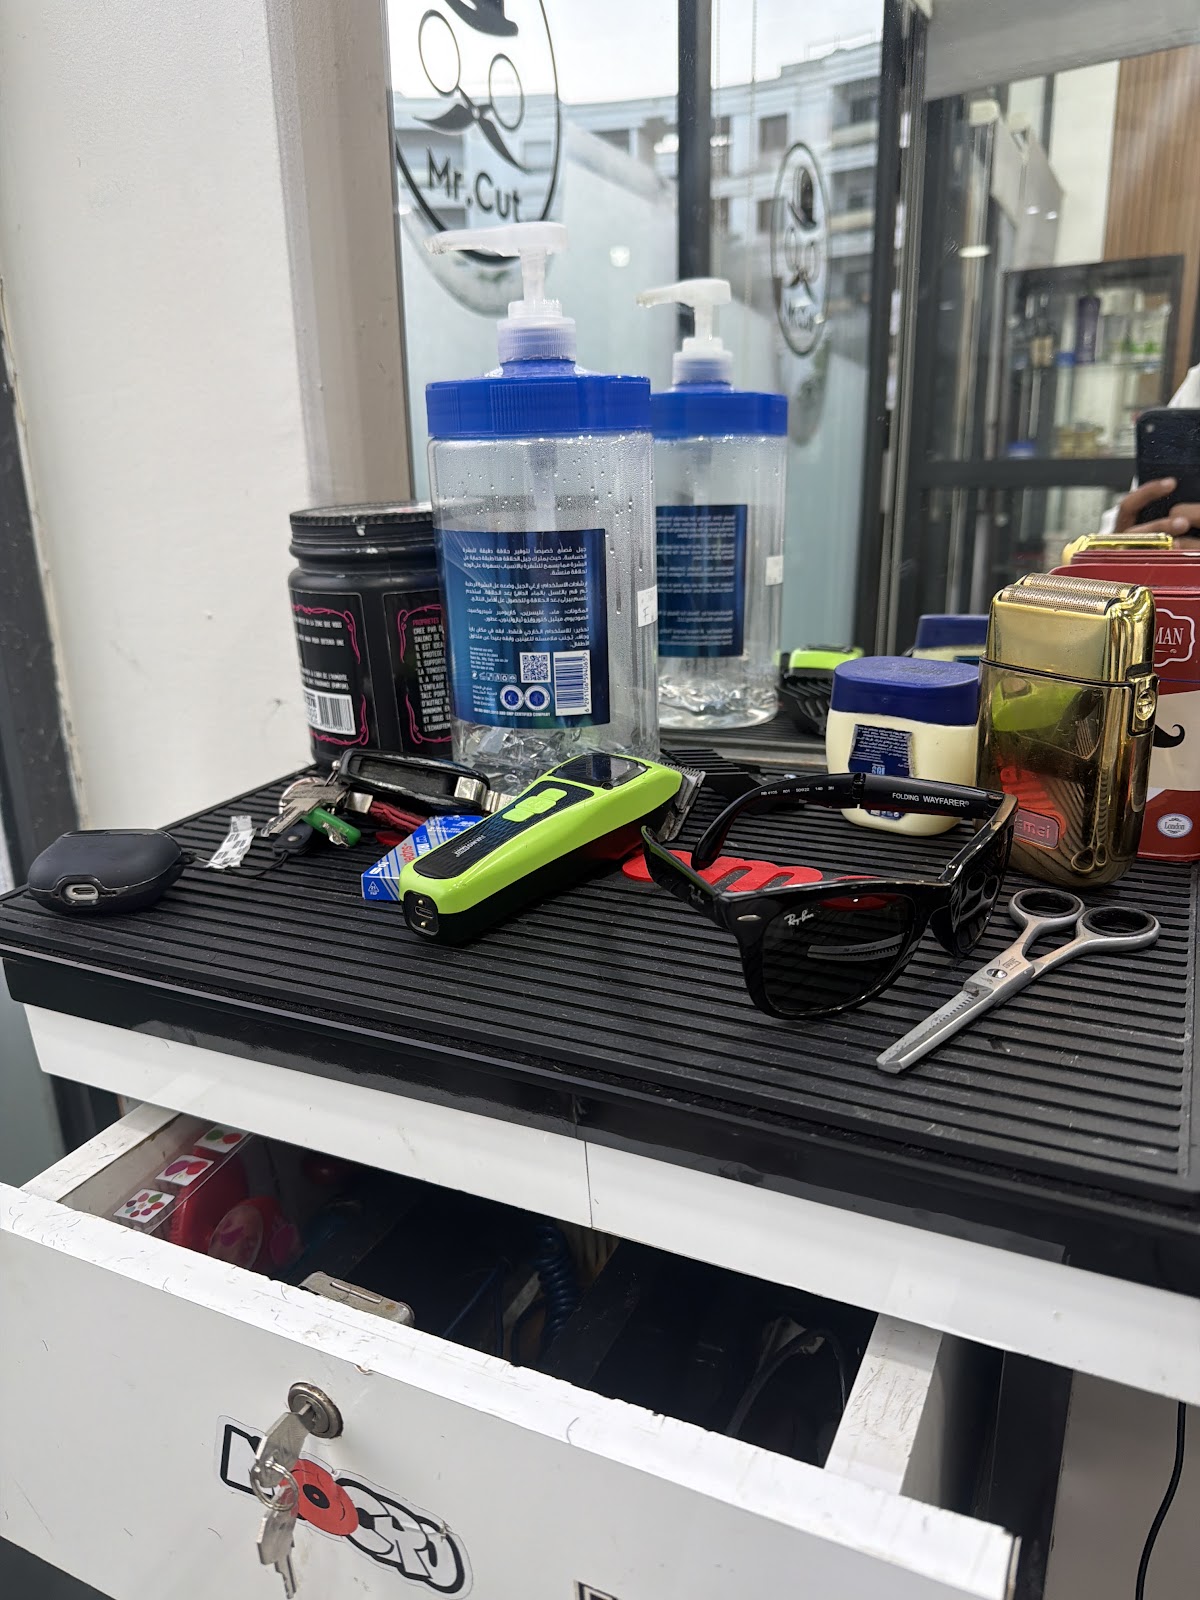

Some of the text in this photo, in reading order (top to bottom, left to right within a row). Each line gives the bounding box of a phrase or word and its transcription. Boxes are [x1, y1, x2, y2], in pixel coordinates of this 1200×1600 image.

[427, 146, 522, 223] Mr.Cut
[433, 641, 444, 649] IDEA
[424, 722, 451, 732] L'ECHAUFFEM
[892, 792, 920, 802] FOLDING
[1164, 821, 1185, 830] London
[400, 844, 416, 864] supe
[784, 908, 815, 926] Ray-Ban
